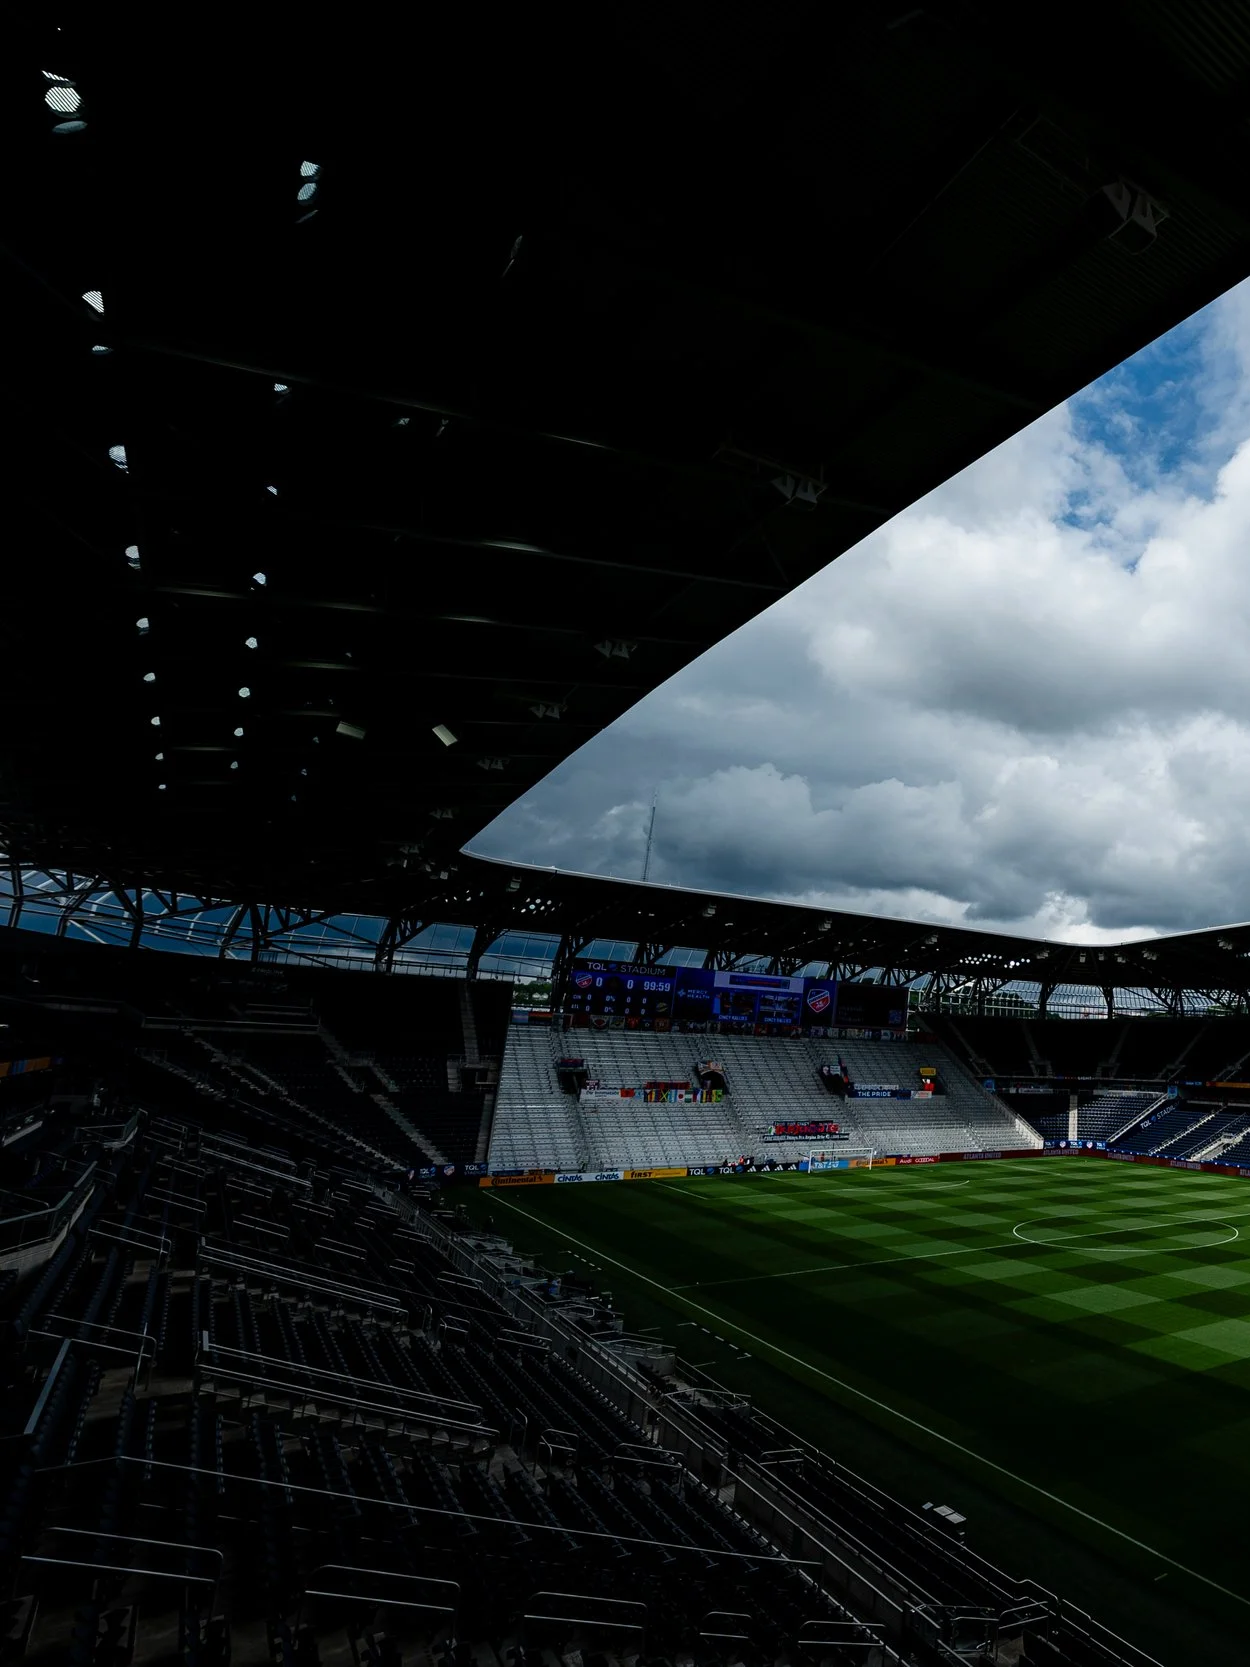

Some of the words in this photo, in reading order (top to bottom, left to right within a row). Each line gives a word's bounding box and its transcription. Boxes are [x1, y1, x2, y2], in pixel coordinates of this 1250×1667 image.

[587, 961, 607, 971] TQL
[620, 965, 666, 976] STADIUM
[595, 977, 603, 987] 0
[626, 980, 634, 990] 0
[643, 981, 671, 991] 99:59
[688, 1168, 706, 1176] TQL
[718, 1166, 735, 1174] TQL
[557, 1174, 583, 1182] CINTAS
[595, 1172, 619, 1180] CINTAS
[491, 1175, 537, 1186] Continental
